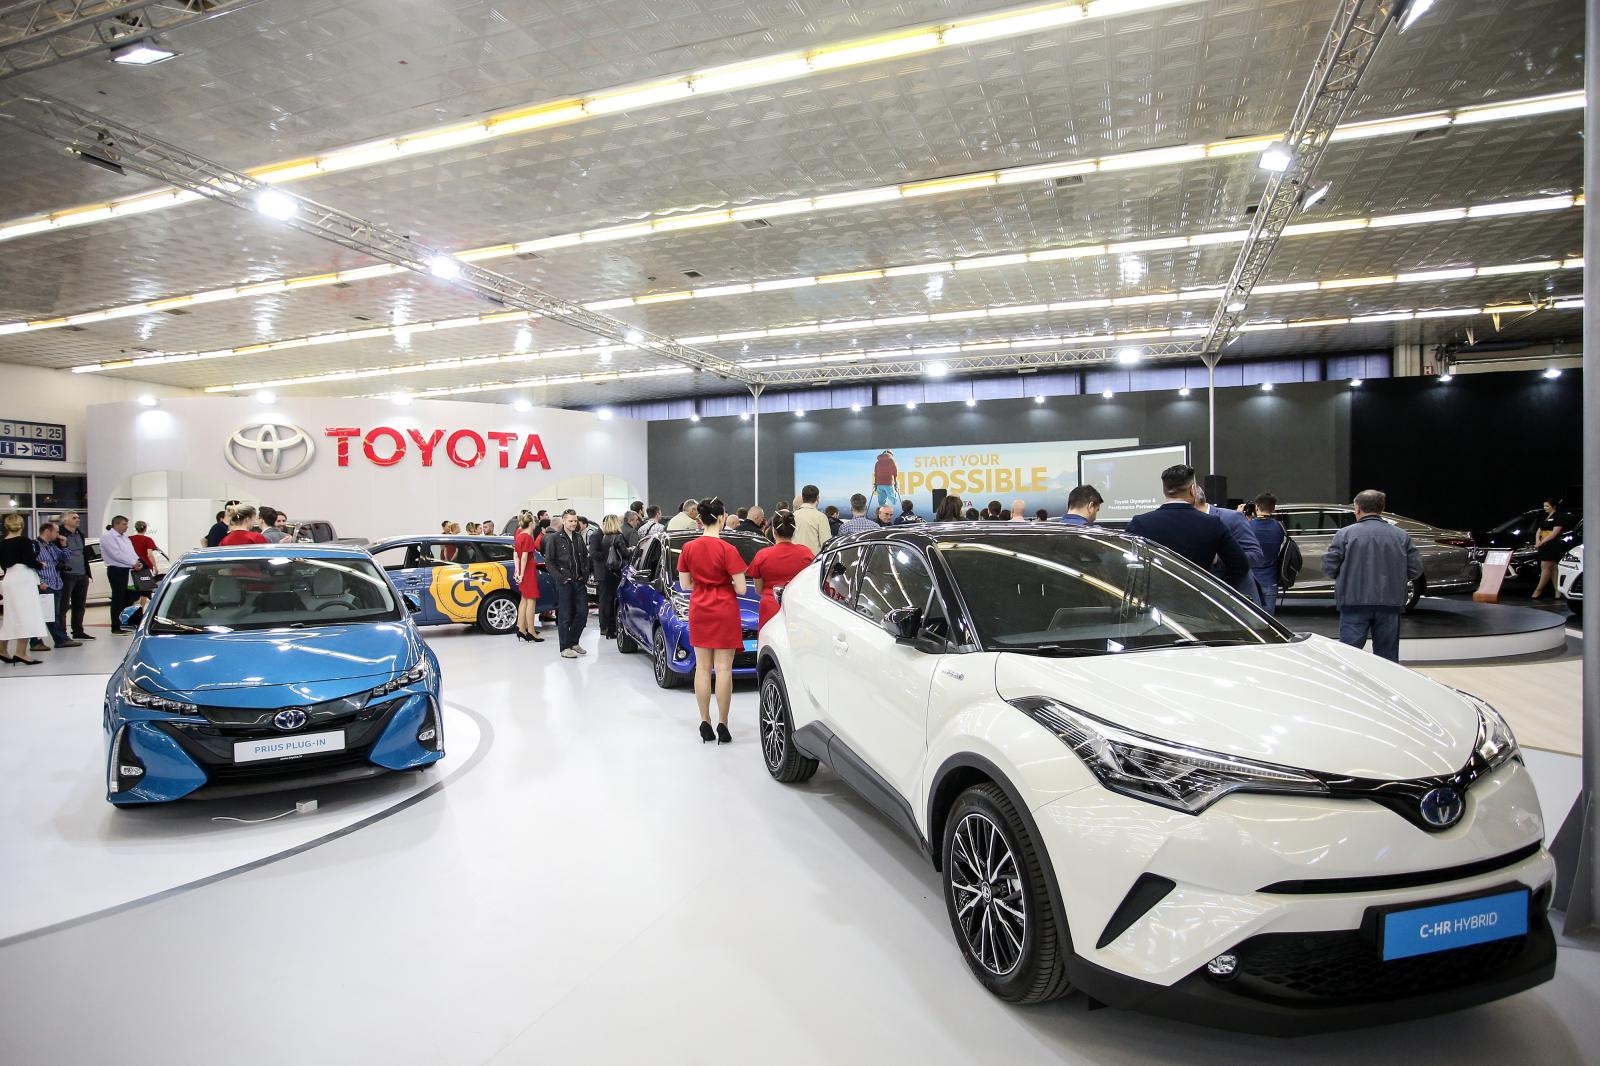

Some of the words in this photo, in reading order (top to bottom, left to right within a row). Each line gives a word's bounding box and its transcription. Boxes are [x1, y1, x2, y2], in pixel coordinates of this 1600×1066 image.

[3, 424, 10, 435] 5
[20, 426, 25, 436] 1
[35, 427, 43, 437] 2
[48, 428, 61, 439] 25
[33, 446, 47, 454] WC
[325, 426, 551, 470] TOYOTA
[914, 454, 956, 469] START
[960, 453, 1000, 467] YOUR
[254, 743, 284, 754] PRIUS
[286, 738, 326, 750] PLUG-IN
[1420, 921, 1451, 938] C-HR
[1454, 911, 1498, 932] HYBRID
